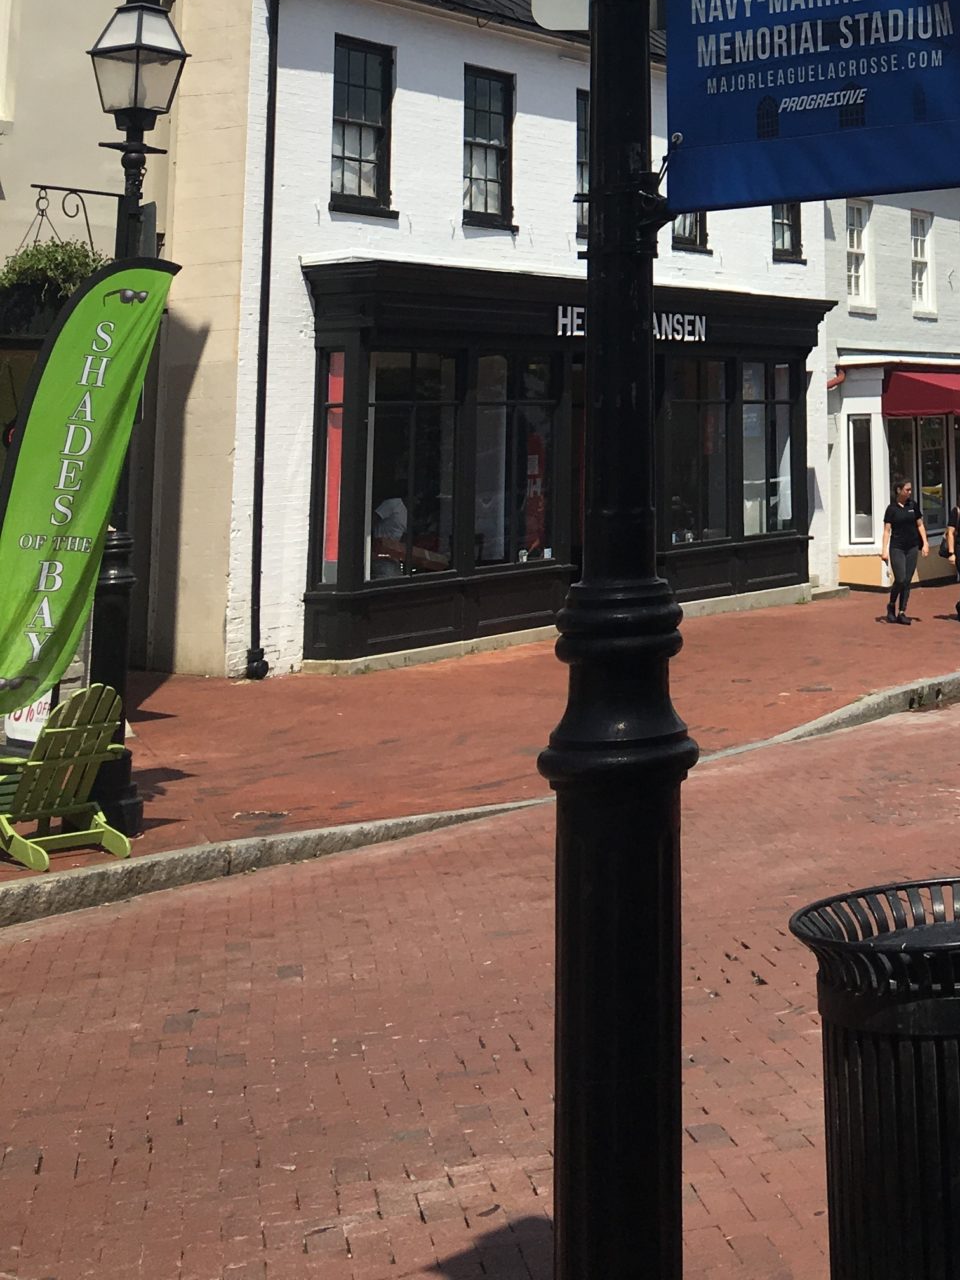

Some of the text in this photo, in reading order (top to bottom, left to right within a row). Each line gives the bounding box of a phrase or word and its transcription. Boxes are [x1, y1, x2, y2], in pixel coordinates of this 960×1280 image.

[697, 1, 954, 68] MEMORIAL STADIUM
[707, 49, 944, 95] MAJORLEAGUELACROSSE.COM
[778, 88, 868, 113] PROGRESSIVE
[652, 312, 706, 342] ANSEN
[51, 320, 115, 527] SHADES
[19, 534, 93, 553] OF THE
[25, 560, 64, 664] BAY
